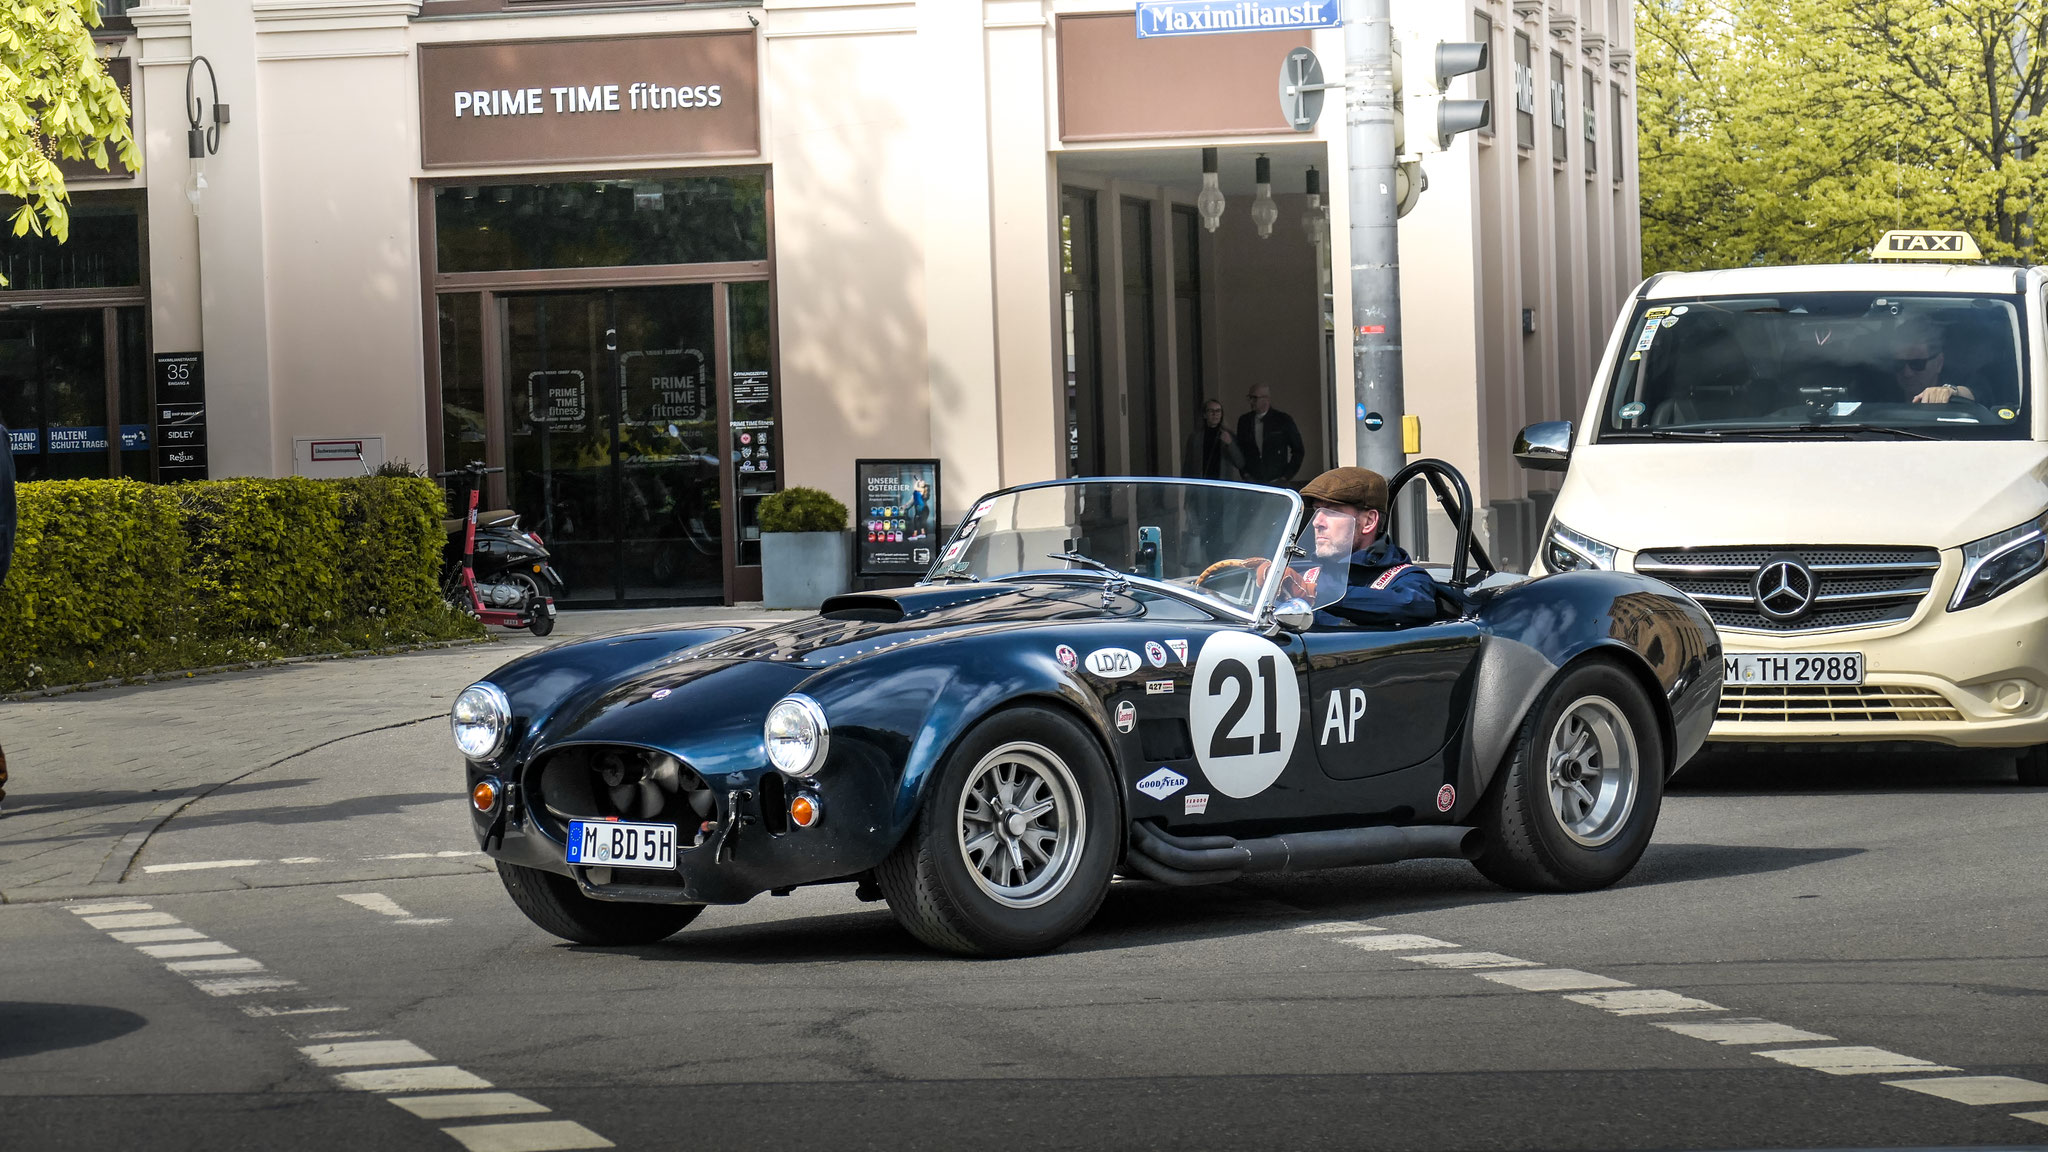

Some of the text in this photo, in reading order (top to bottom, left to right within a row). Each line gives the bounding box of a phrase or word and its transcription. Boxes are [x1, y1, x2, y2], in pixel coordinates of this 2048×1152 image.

[1152, 4, 1327, 31] Maximilianstr.
[454, 83, 722, 117] PRIME TIME fitness
[1891, 235, 1962, 251] TAXI
[167, 363, 190, 380] 35
[651, 376, 695, 389] PRIME
[549, 387, 578, 397] PRIME
[662, 391, 696, 404] TIME
[556, 398, 578, 407] TIME
[549, 406, 579, 416] fitness
[651, 404, 696, 417] fitness
[51, 430, 87, 440] HALTEN!
[167, 431, 194, 439] SIDLEY
[51, 441, 80, 449] SCHUTZ
[169, 451, 194, 462] Regus
[867, 484, 910, 492] OSTEREIER
[1724, 657, 1858, 681] M TH 2988
[1148, 683, 1162, 691] 427
[1208, 655, 1281, 759] 21
[1118, 711, 1133, 722] Castrol
[1320, 688, 1367, 746] AP
[583, 827, 672, 862] M BD 5H
[571, 846, 578, 856] D
